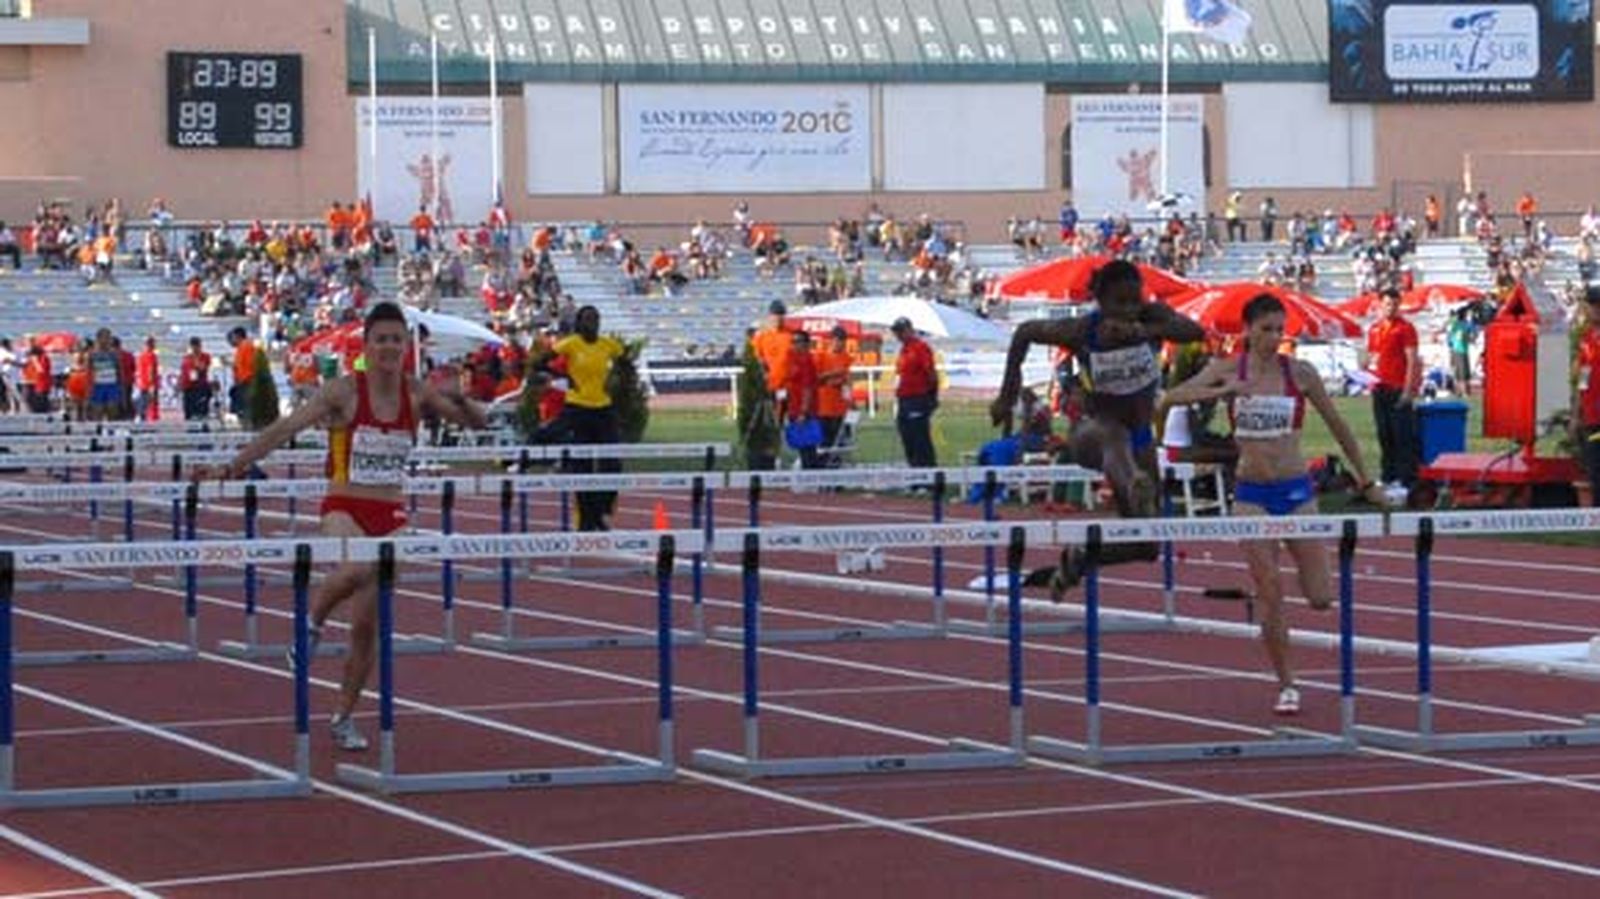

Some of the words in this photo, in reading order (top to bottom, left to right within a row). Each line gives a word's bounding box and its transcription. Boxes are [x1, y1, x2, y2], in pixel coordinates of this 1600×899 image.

[434, 14, 617, 34] CIUDAD
[664, 16, 935, 36] DEPORTIVA
[980, 17, 1119, 35] BAHIA
[408, 42, 787, 58] AYUNTAMIENTO
[830, 43, 880, 58] DE
[925, 43, 1004, 58] SAN
[1049, 43, 1278, 58] FERNANDO
[1392, 43, 1462, 62] BAHIA
[1488, 43, 1529, 62] SUR
[179, 102, 217, 130] 89
[254, 103, 292, 131] 99
[640, 109, 675, 125] SAN
[679, 109, 777, 125] FERNANDO
[178, 132, 219, 145] LOCAL
[812, 532, 840, 547] SAN
[841, 528, 925, 546] FERNANDO
[928, 527, 964, 542] 2010
[1149, 525, 1180, 538] SAN
[1181, 522, 1259, 537] FERNANDO
[1263, 522, 1297, 533] 2010
[72, 549, 107, 564] SAN
[108, 545, 199, 564] FERNANDO
[204, 546, 243, 559] 2010
[450, 540, 475, 555] SAN
[476, 537, 570, 555] FERNANDO
[574, 536, 611, 551] 2010
